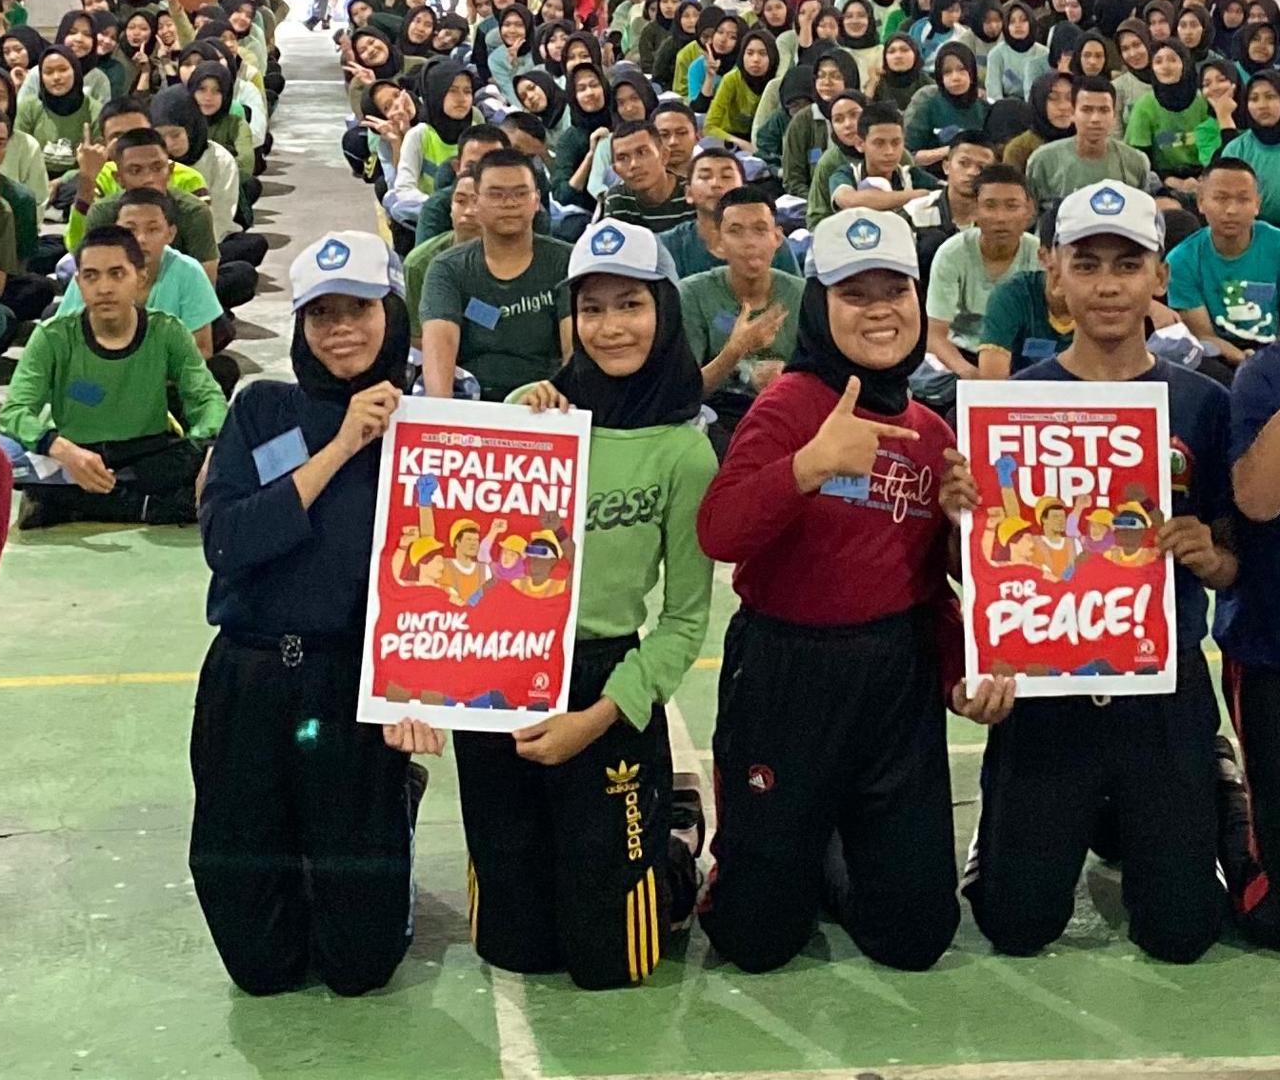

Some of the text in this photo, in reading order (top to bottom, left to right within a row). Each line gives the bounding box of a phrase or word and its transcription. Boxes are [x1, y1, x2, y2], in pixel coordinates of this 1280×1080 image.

[398, 446, 573, 486] KEPALKAN
[988, 425, 1144, 467] FISTS
[1017, 466, 1112, 509] UP!
[999, 579, 1037, 600] FOR
[397, 610, 470, 633] UNTUK
[985, 584, 1152, 647] PEACE!
[380, 628, 556, 663] PERDAMAIAN!
[625, 791, 644, 861] adidas
